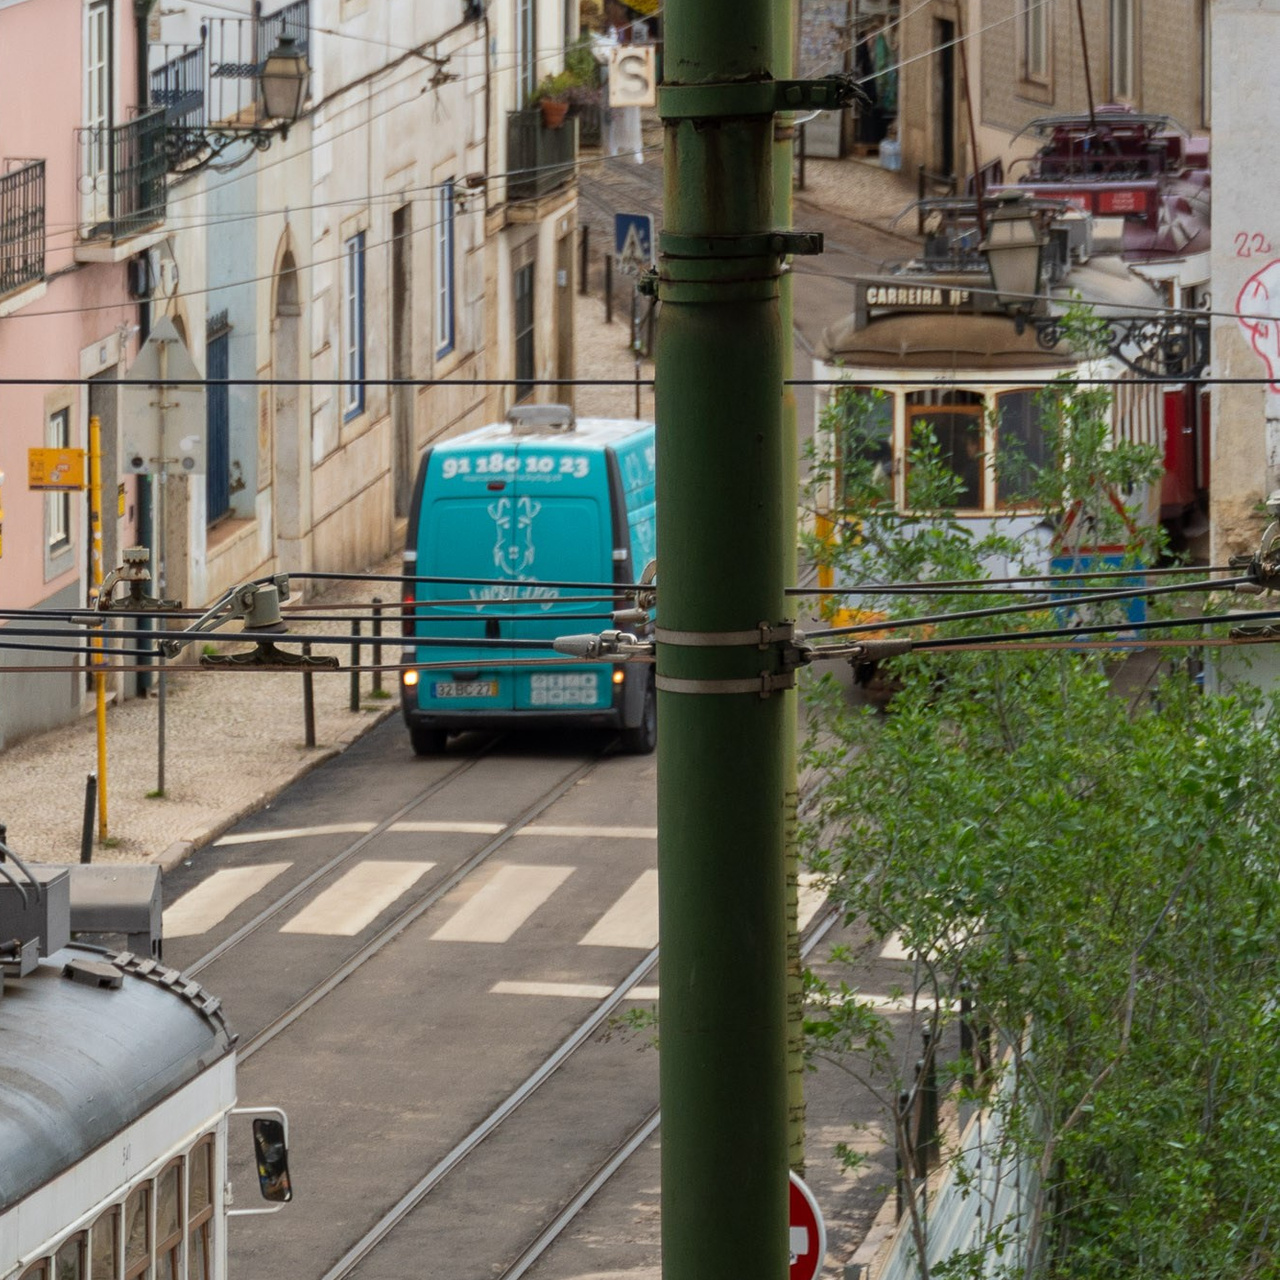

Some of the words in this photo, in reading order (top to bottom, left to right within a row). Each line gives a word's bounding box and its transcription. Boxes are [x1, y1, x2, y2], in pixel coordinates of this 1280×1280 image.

[619, 55, 649, 98] S
[866, 287, 942, 305] CARREIRA
[442, 457, 471, 479] 91
[475, 452, 520, 473] 180
[525, 456, 554, 473] 10
[559, 456, 590, 478] 23
